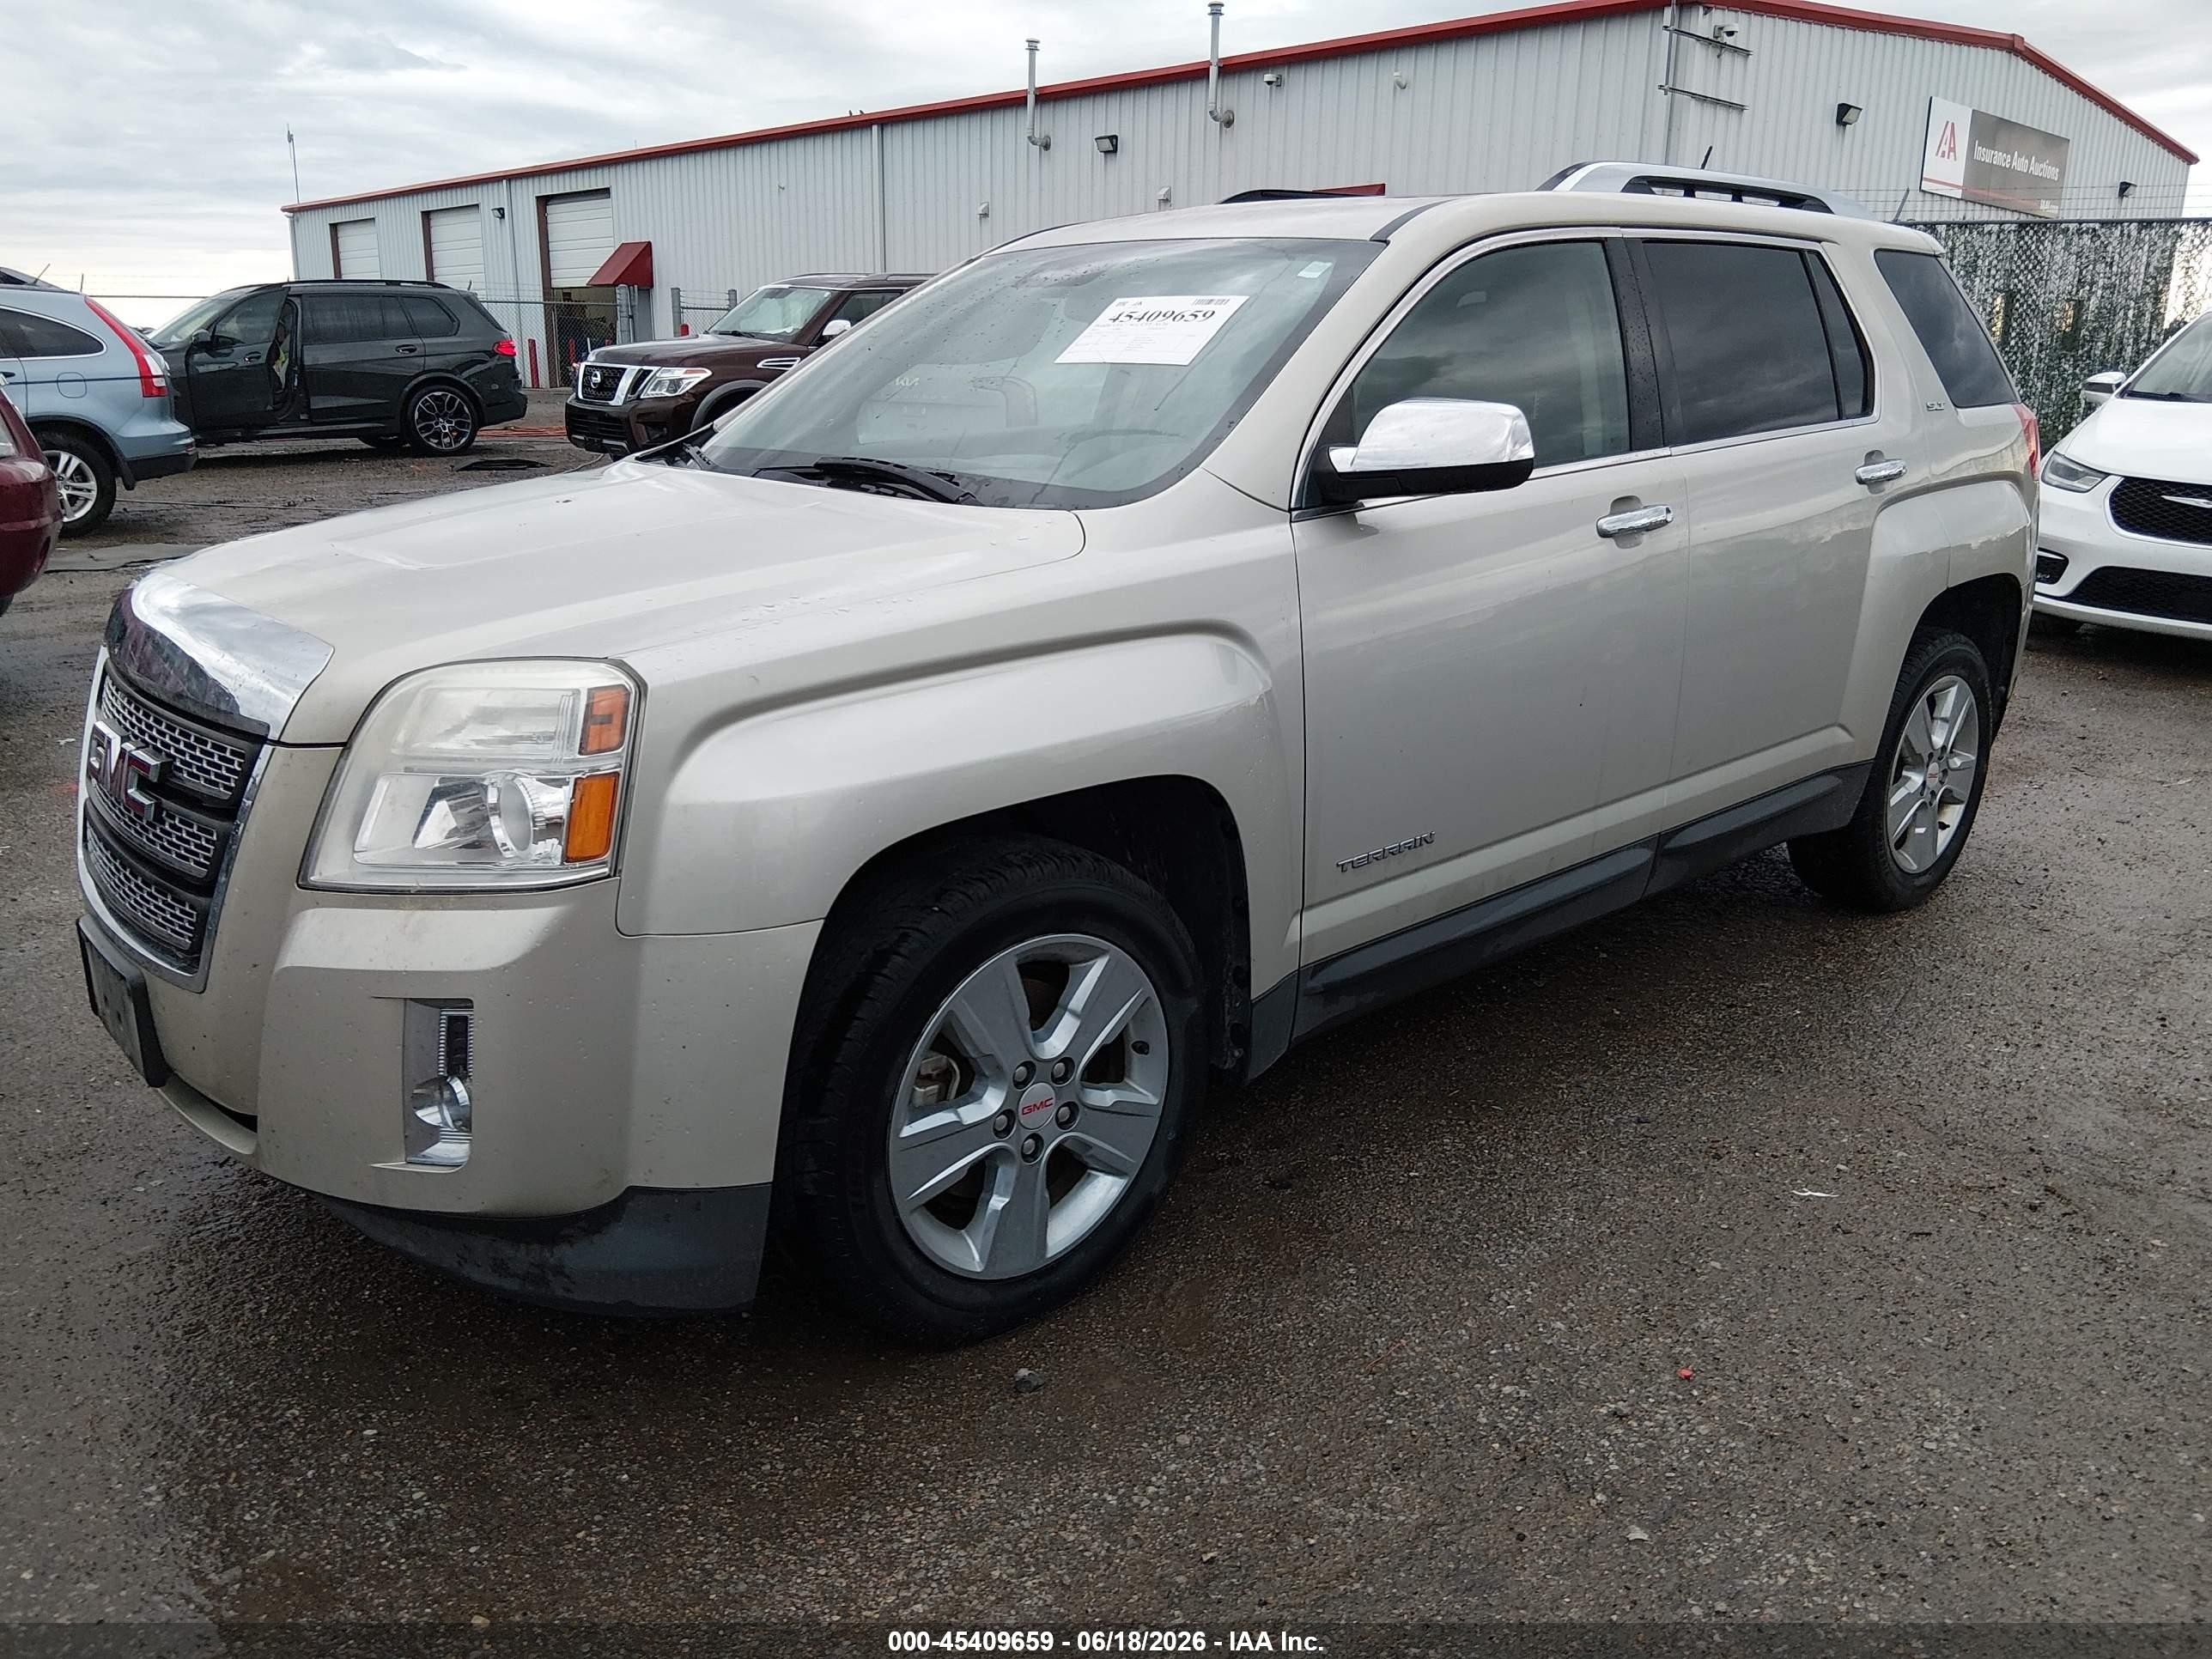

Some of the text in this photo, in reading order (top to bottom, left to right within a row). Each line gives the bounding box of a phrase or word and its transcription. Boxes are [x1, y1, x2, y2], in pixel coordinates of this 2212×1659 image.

[1973, 140, 2059, 181] Insurance Auto Auctions
[1109, 309, 1216, 323] 45409659
[86, 720, 161, 823] GMC
[1336, 830, 1435, 872] TERRAIN
[1021, 1097, 1054, 1115] GMC
